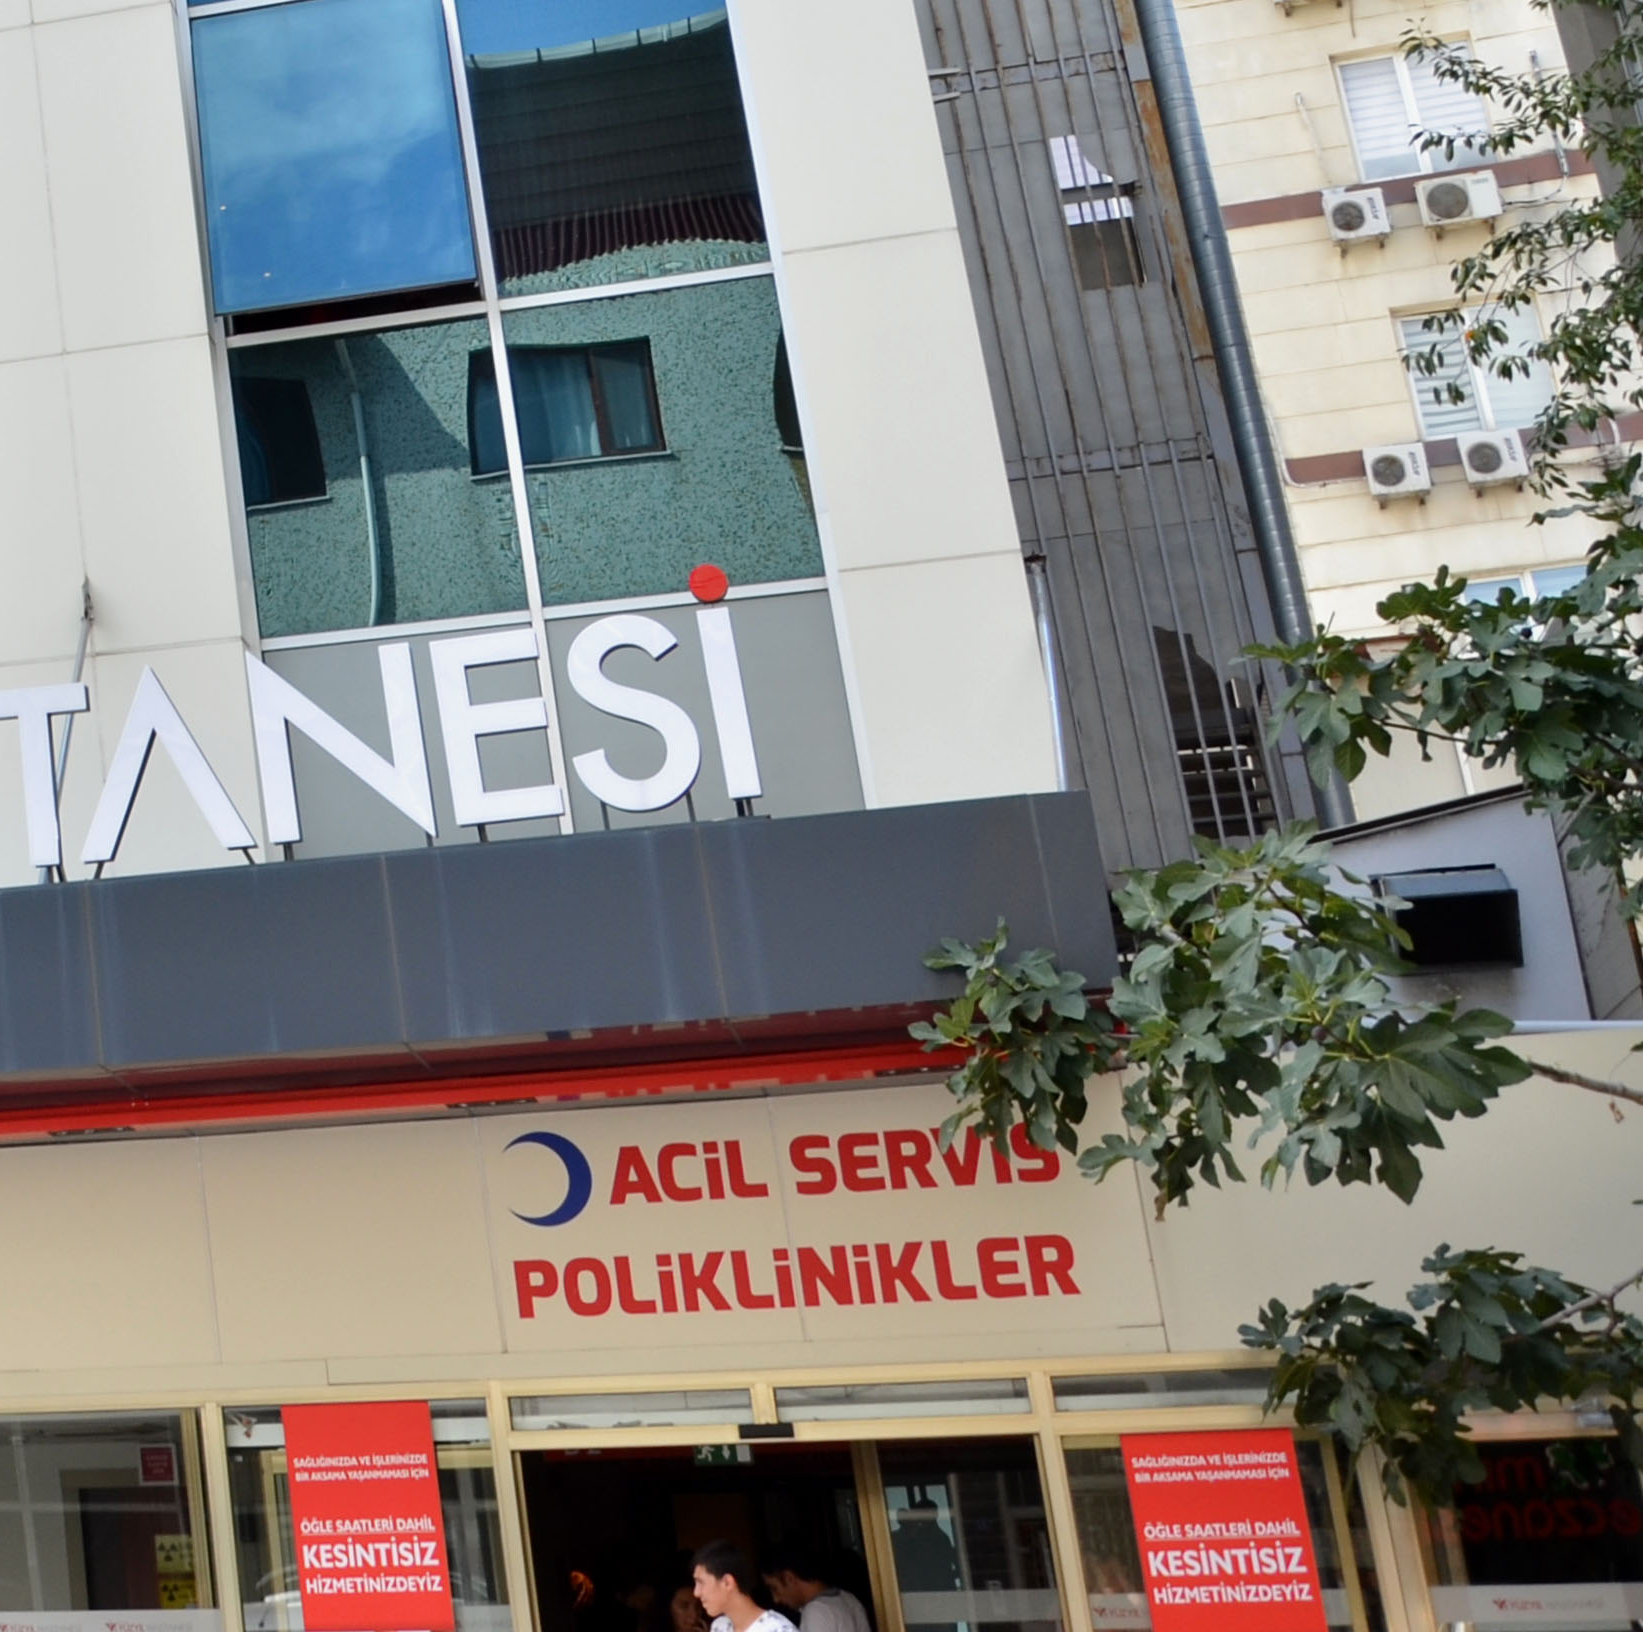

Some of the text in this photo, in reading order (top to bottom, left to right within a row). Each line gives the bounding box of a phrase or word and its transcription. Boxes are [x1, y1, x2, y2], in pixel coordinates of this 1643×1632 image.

[300, 1514, 436, 1533] ÖĞLE SAATLERİ DAHİL
[1144, 1517, 1301, 1538] ÖĞLE SAATLERİ DAHİL
[302, 1535, 440, 1568] KESİNTİSİZ
[1147, 1540, 1307, 1577] KESİNTİSİZ
[305, 1572, 443, 1594] HİZMETİNİZDEYİZ
[1153, 1580, 1313, 1604] HİZMETİNİZDEYİZ
